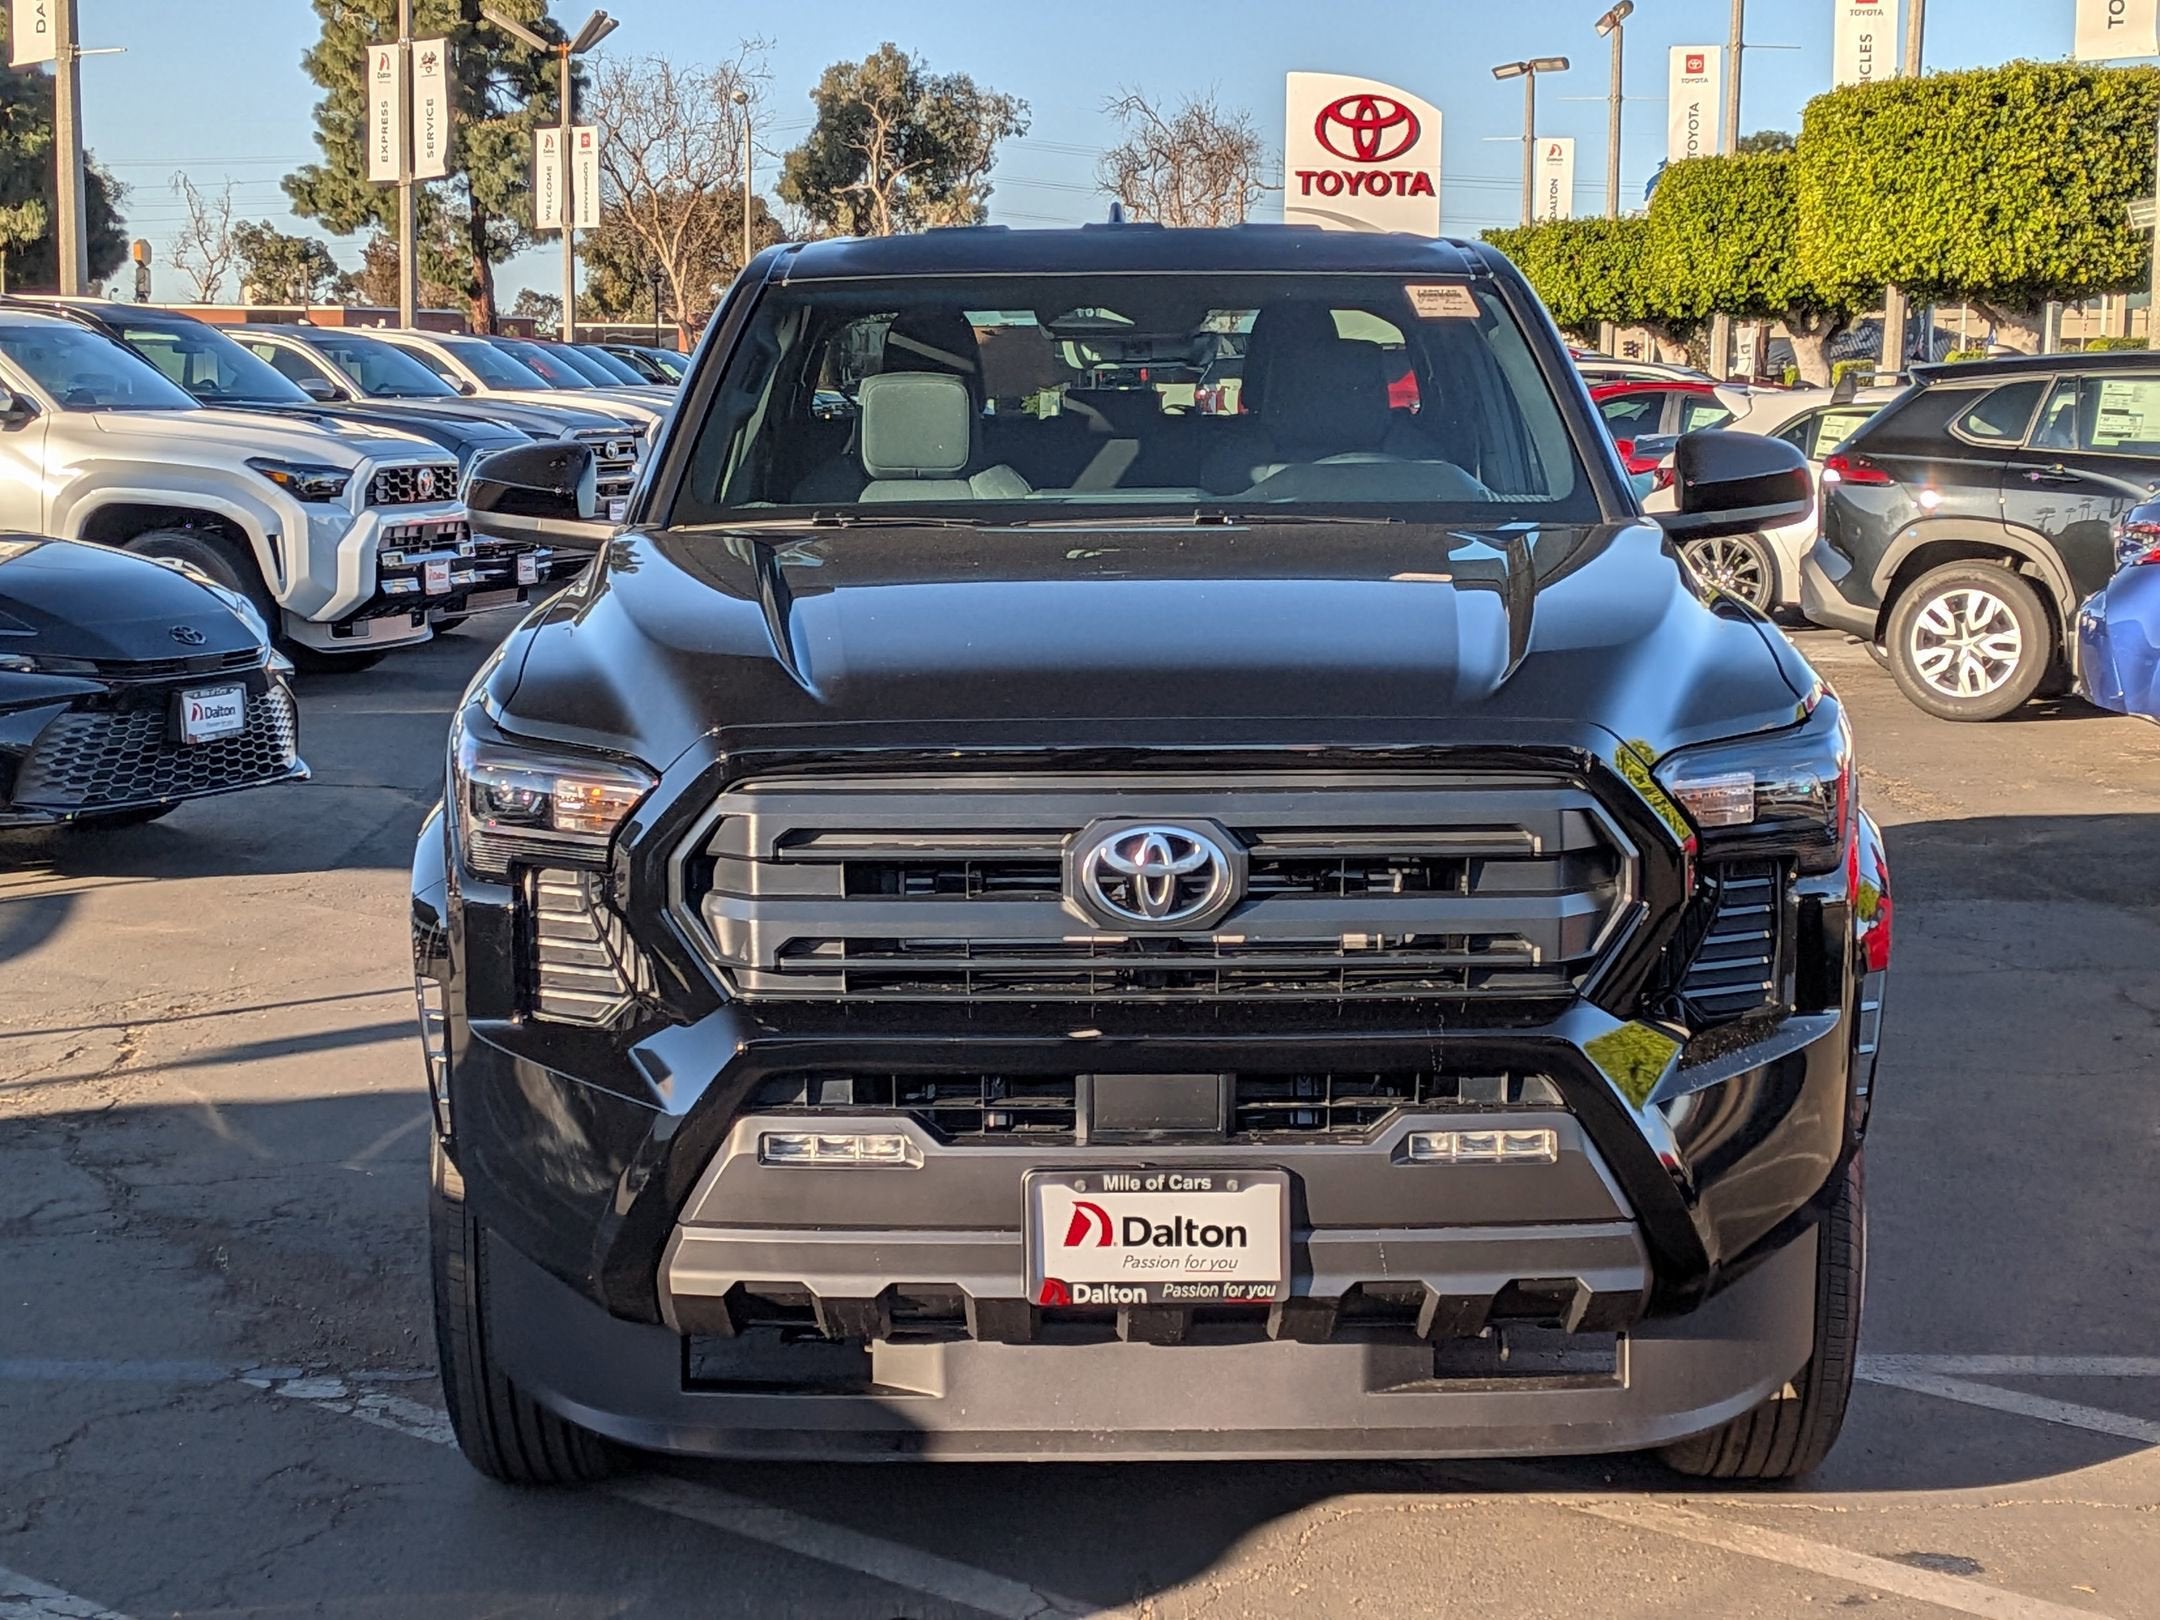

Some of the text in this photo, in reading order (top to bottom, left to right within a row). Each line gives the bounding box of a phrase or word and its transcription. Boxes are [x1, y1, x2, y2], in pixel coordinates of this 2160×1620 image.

[2108, 0, 2125, 29] TO
[1687, 102, 1699, 158] TOYOTA
[1295, 170, 1436, 197] TOYOTA
[205, 705, 236, 719] Dalton
[1103, 1175, 1212, 1191] Mile of Cars
[1122, 1216, 1247, 1248] Dalton
[1122, 1254, 1238, 1271] Passion for you
[1072, 1283, 1277, 1304] Dalton Passion for you
